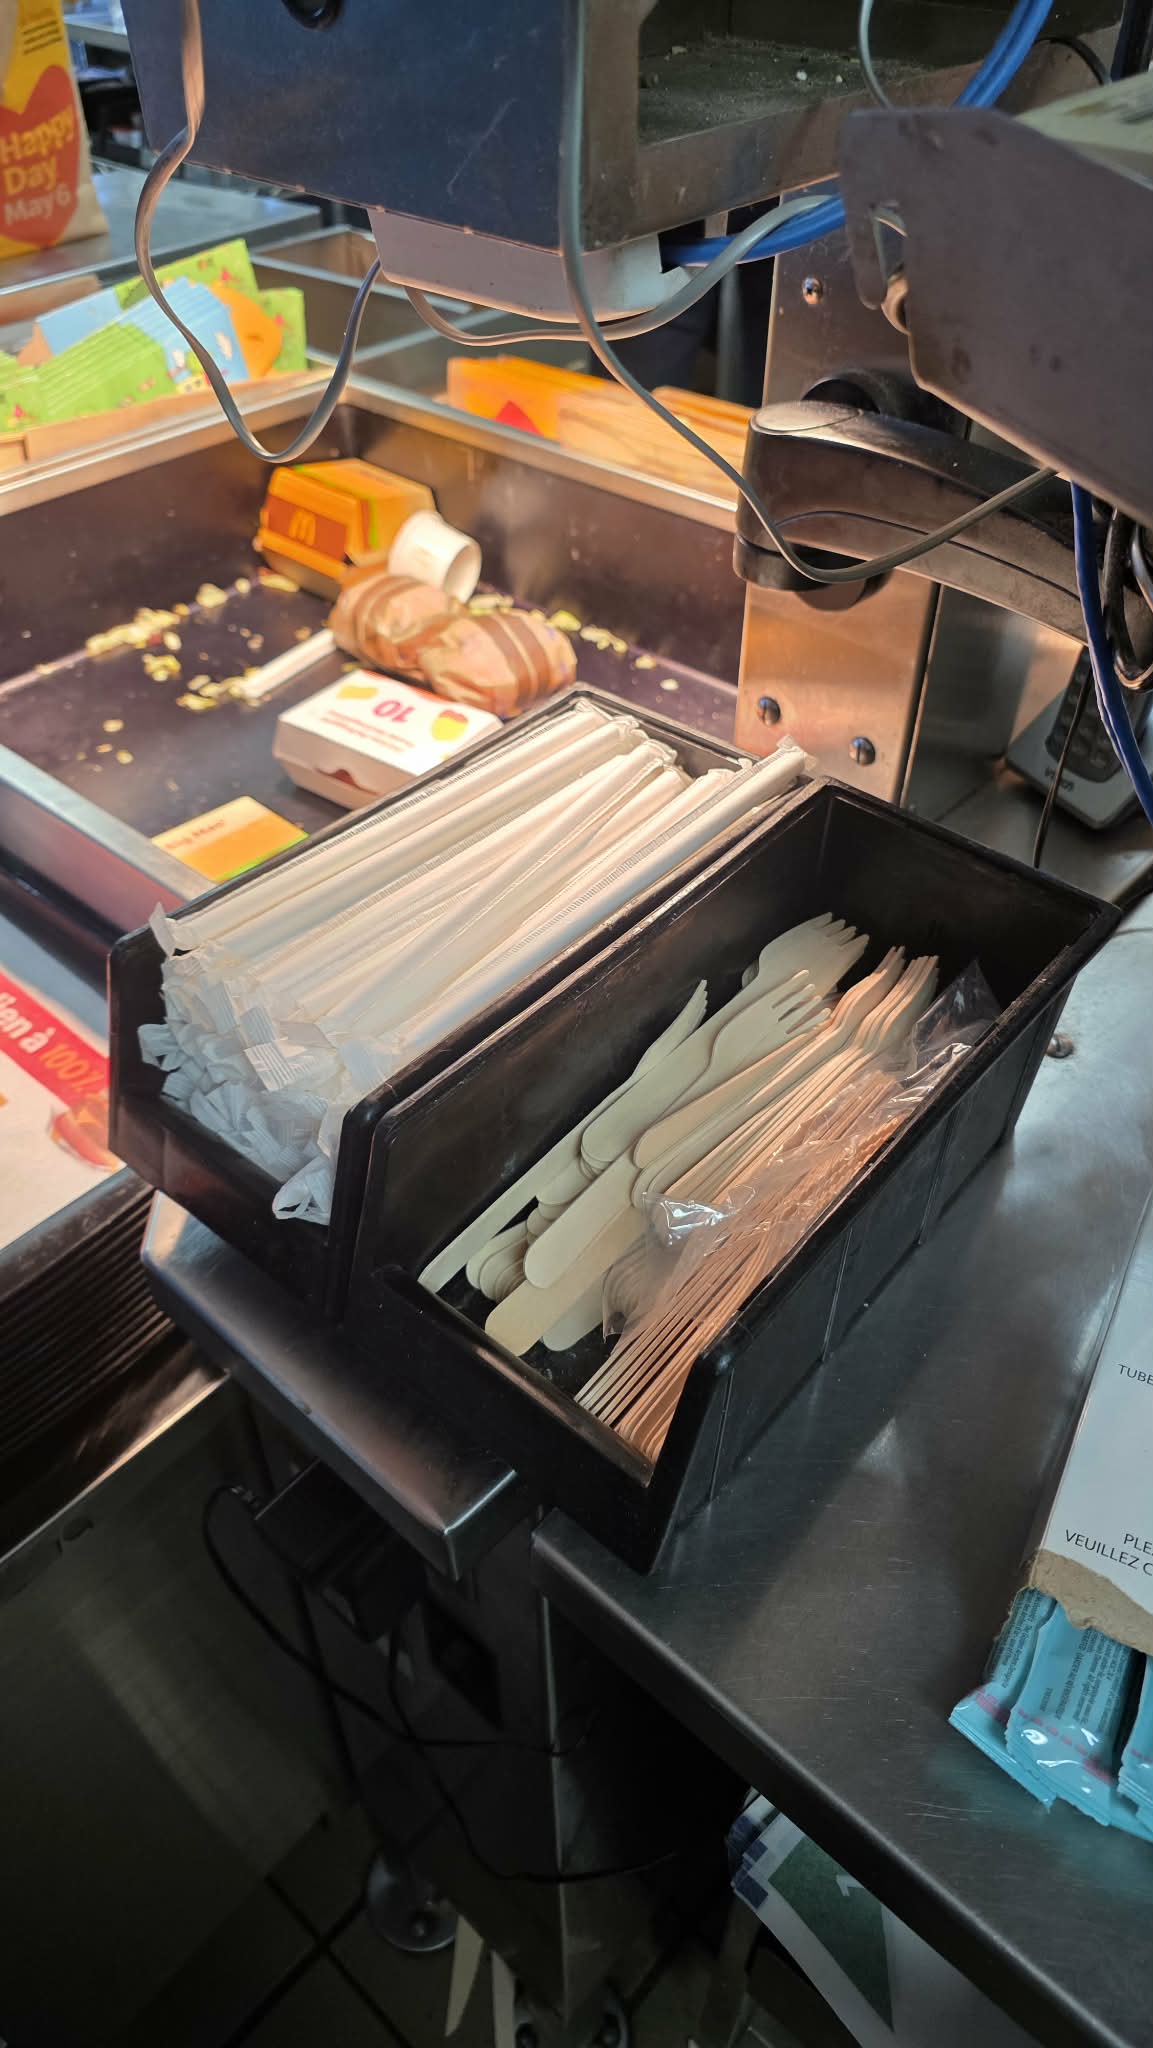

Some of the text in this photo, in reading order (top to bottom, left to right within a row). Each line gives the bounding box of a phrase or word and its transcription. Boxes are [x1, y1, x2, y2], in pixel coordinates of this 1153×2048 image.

[4, 156, 57, 196] Day
[4, 182, 71, 225] May 6
[372, 699, 416, 723] 10
[1065, 1529, 1140, 1570] VEUILLEZ
[1123, 1533, 1153, 1557] PLE
